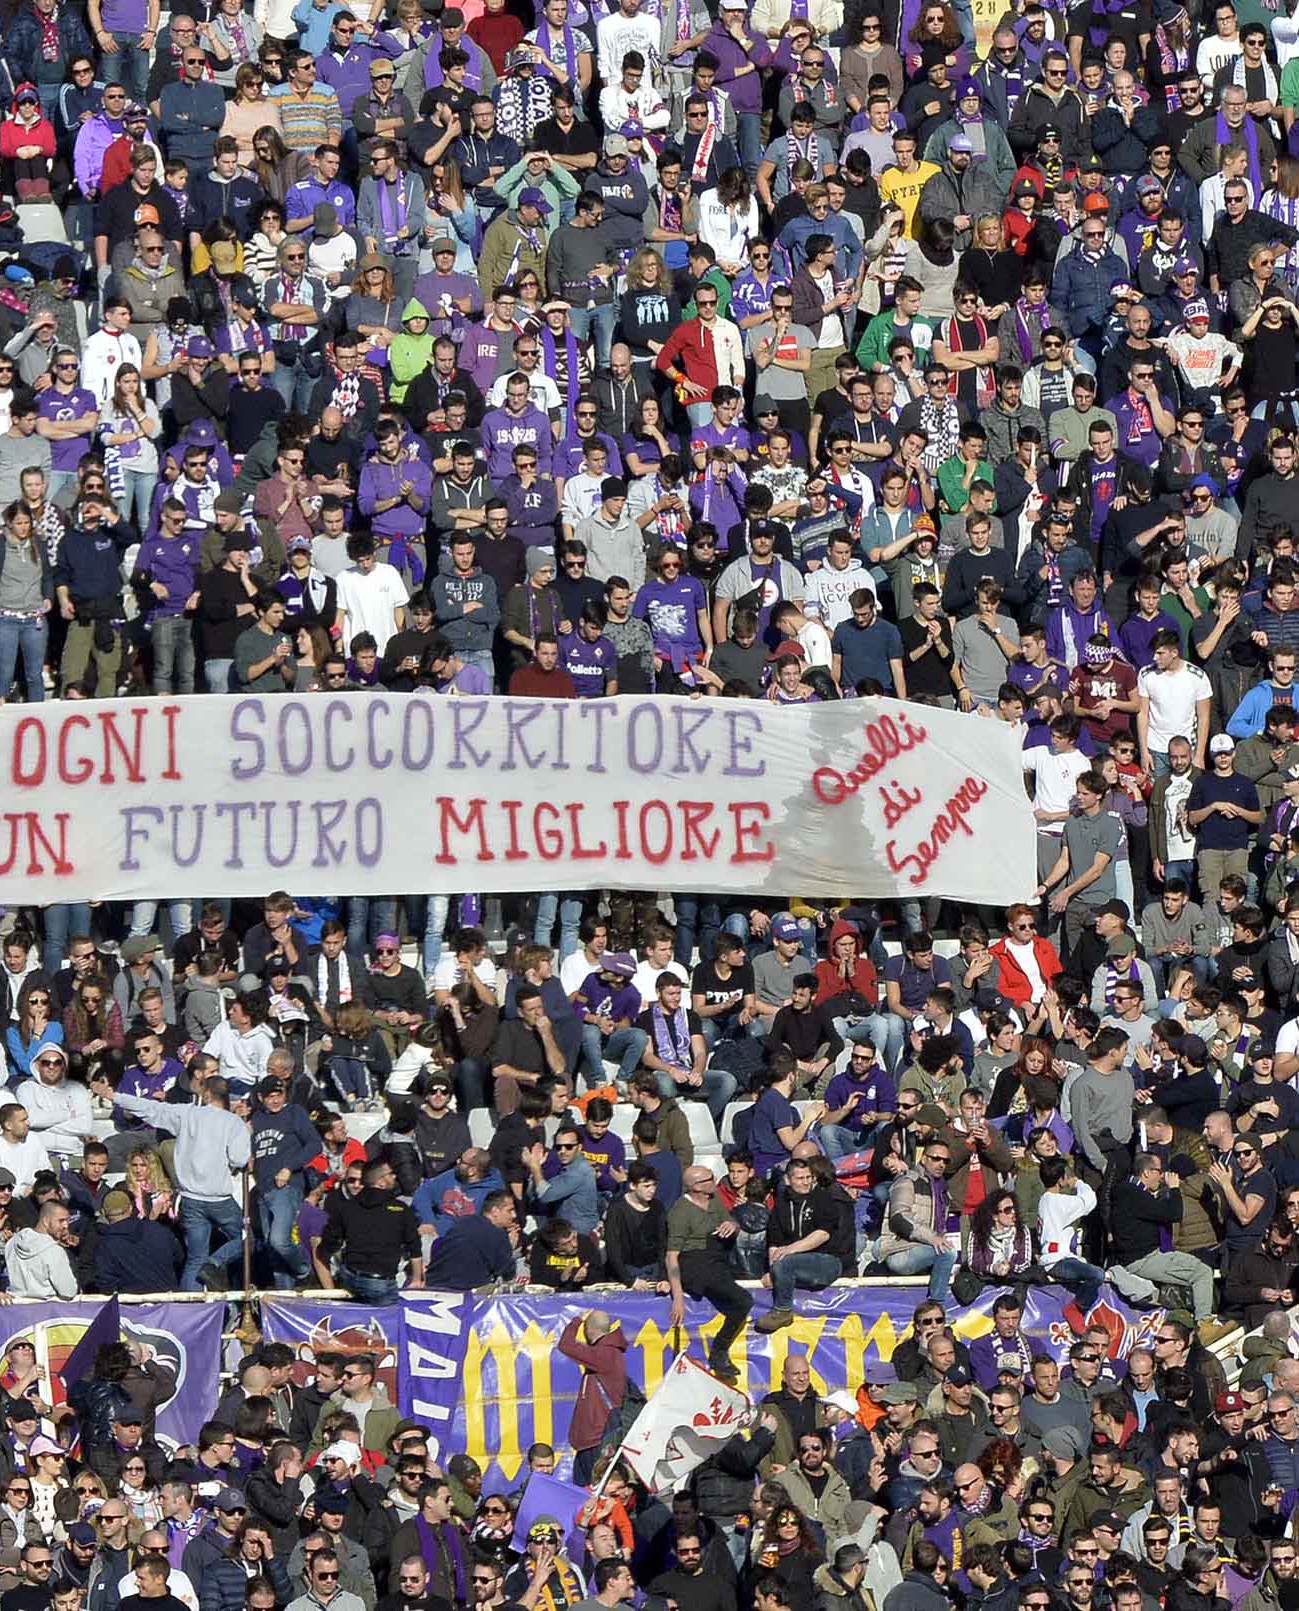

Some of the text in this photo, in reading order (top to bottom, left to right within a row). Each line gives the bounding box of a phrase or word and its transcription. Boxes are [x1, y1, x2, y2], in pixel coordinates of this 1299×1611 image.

[975, 1, 996, 15] 28
[891, 184, 926, 202] PYR
[11, 704, 183, 788] OGNI
[230, 697, 767, 780] SOCCORRITORE
[812, 711, 928, 806] Quelli
[118, 797, 386, 872] FUTURO
[434, 795, 777, 867] MIGLIORE
[880, 779, 923, 831] di
[885, 776, 989, 887] Sempre
